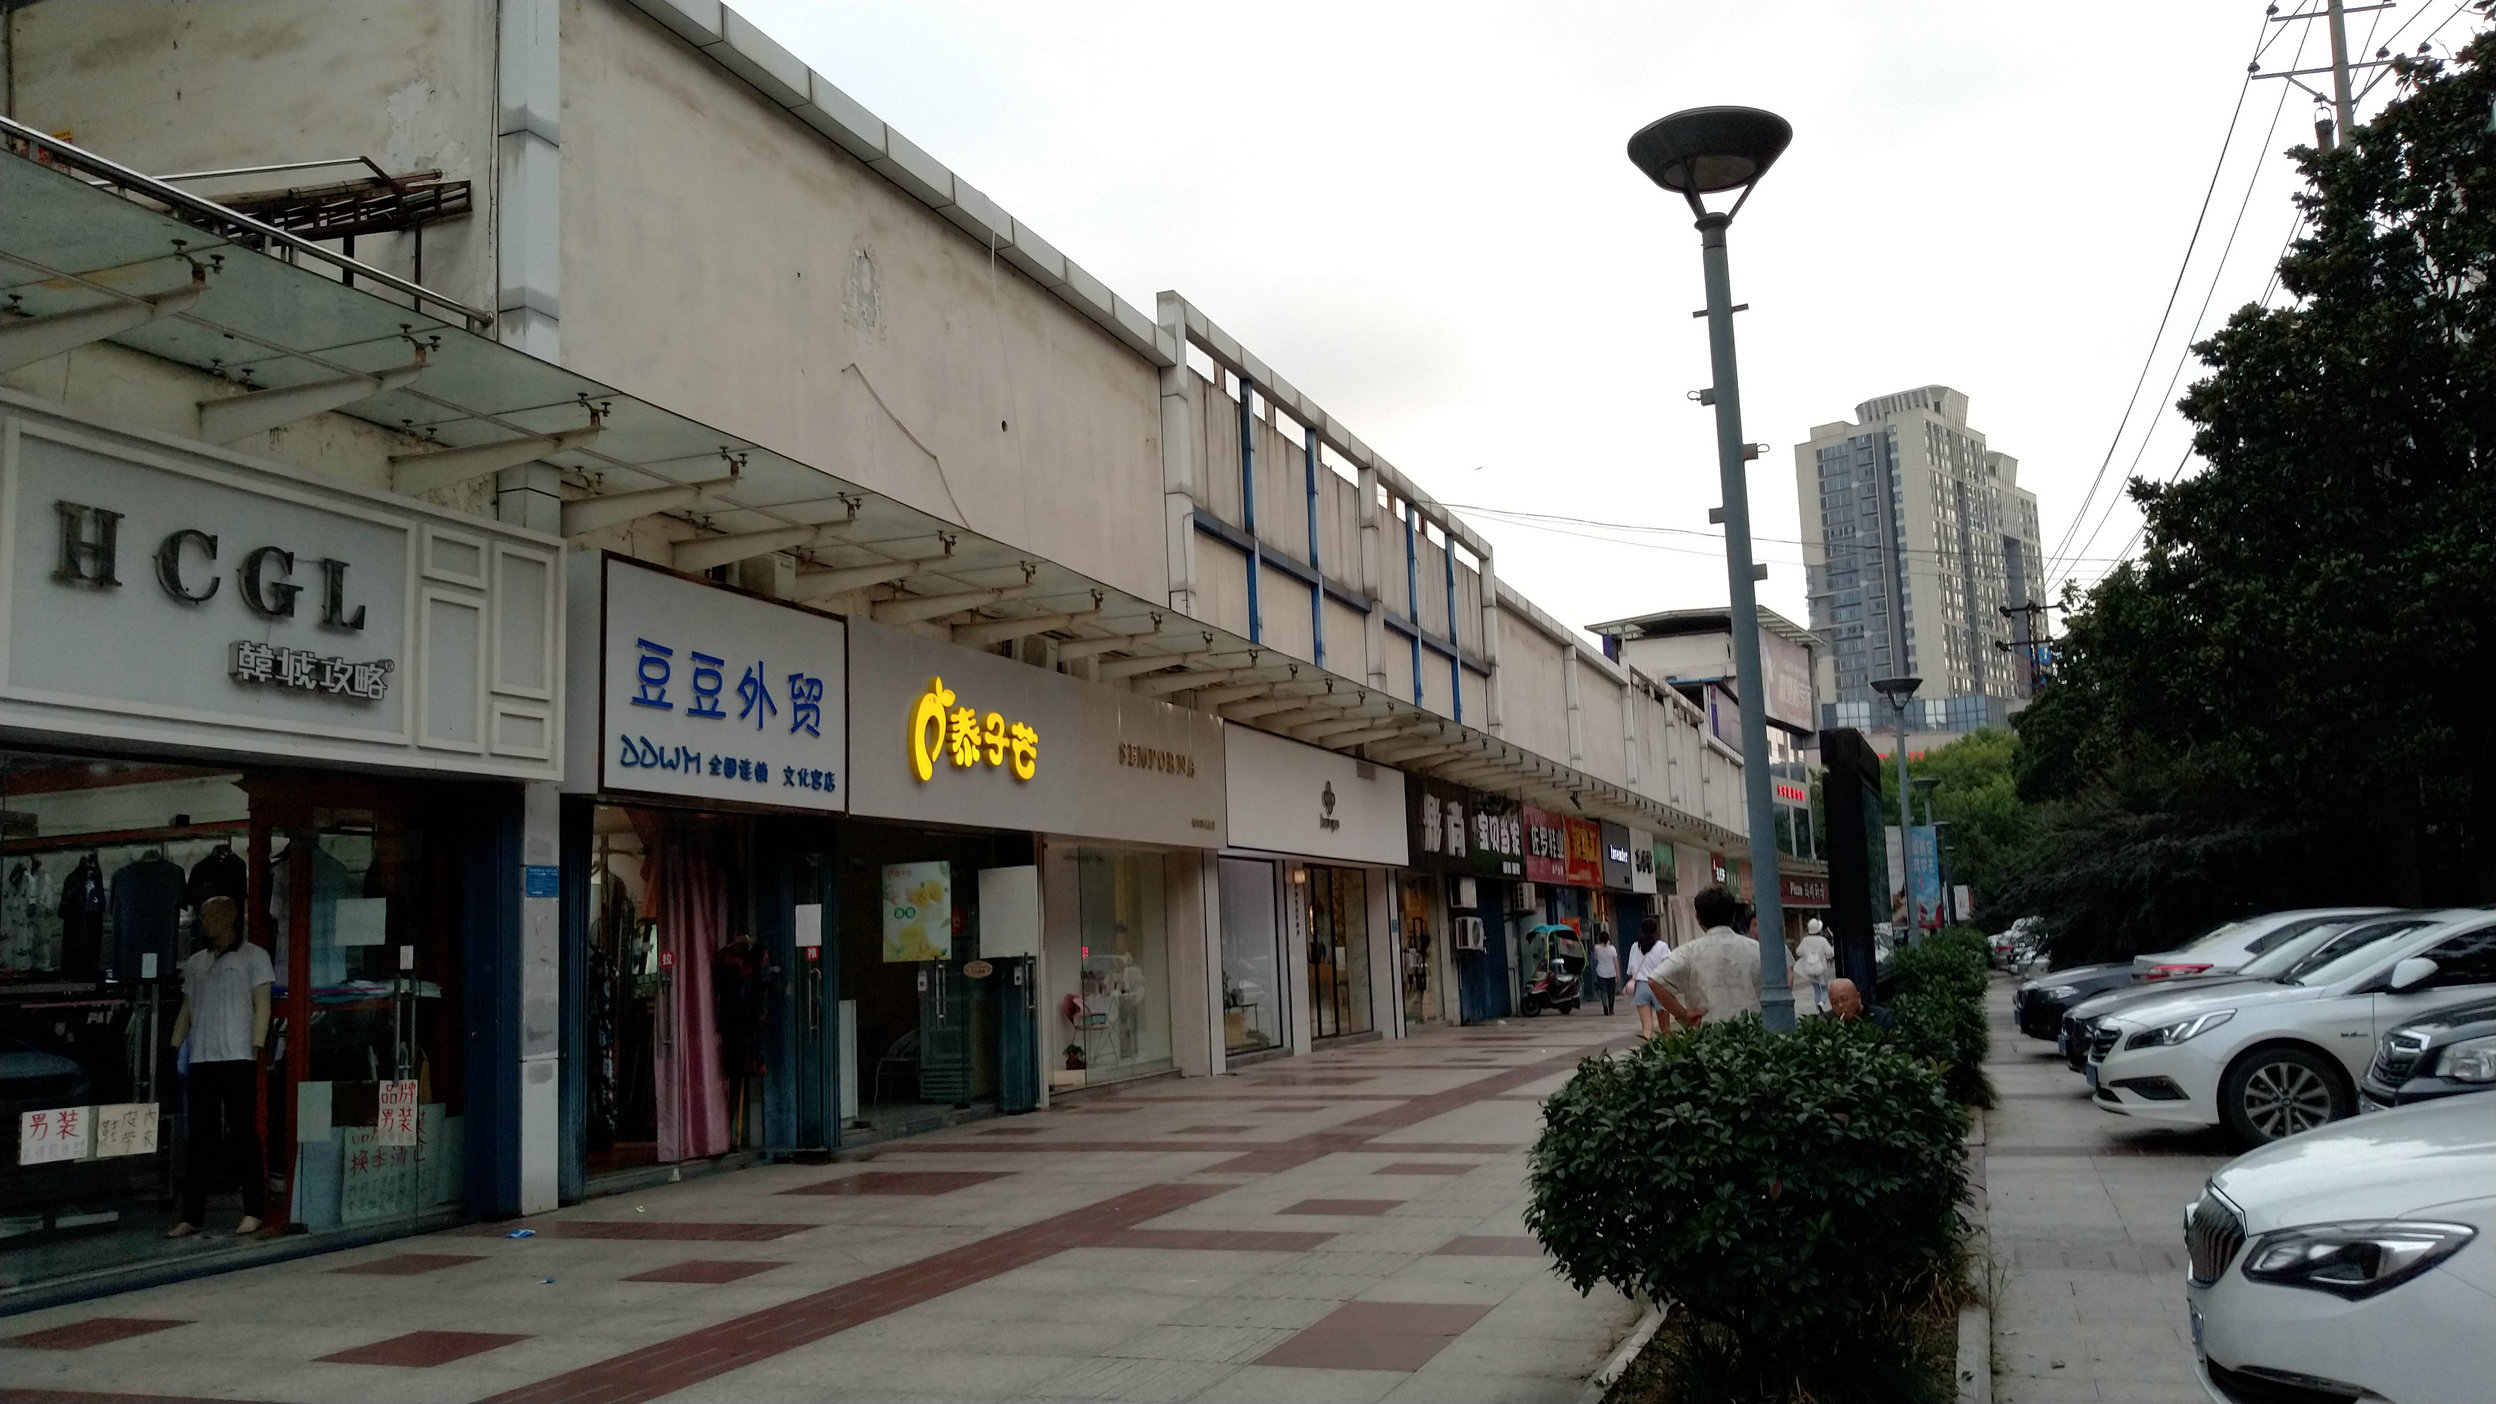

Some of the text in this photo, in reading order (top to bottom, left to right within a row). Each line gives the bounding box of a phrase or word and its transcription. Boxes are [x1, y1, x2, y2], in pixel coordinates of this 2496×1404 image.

[52, 499, 366, 632] HCGL
[632, 637, 823, 737] 豆豆外贸
[947, 707, 1038, 781] 泰子芒
[782, 765, 836, 792] 文化宫店
[1477, 811, 1521, 856] 宝贝当家
[662, 952, 673, 965] 拉
[381, 1083, 416, 1105] 品牌
[29, 1110, 79, 1141] 男装
[381, 1107, 413, 1133] 男装
